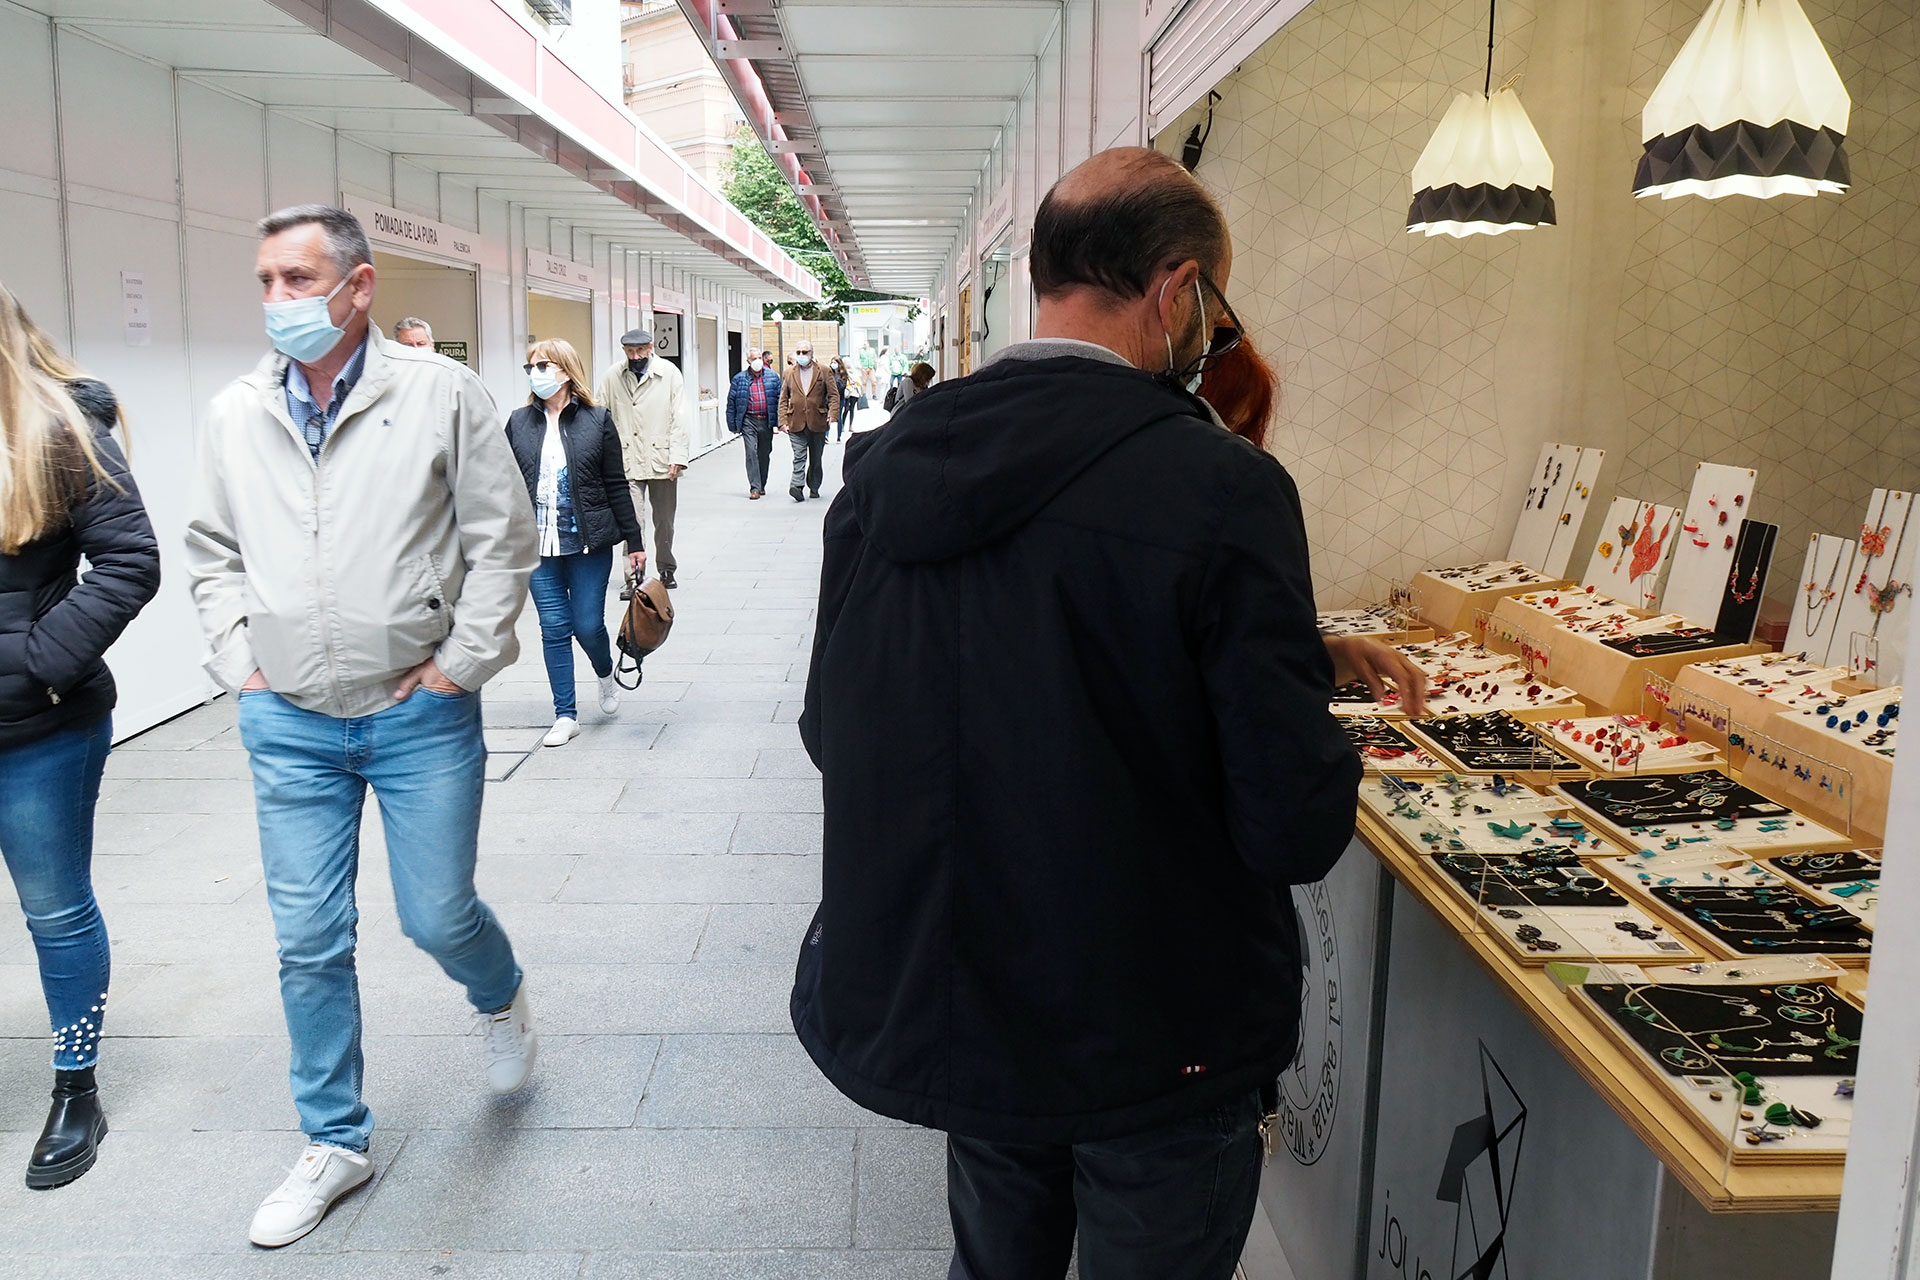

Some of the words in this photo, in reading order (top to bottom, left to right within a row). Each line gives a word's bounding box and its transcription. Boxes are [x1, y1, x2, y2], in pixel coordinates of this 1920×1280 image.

[374, 211, 404, 237] POMADA
[404, 220, 413, 239] DE
[413, 223, 422, 242] LA
[422, 226, 439, 246] PURA
[1310, 1040, 1338, 1140] agua
